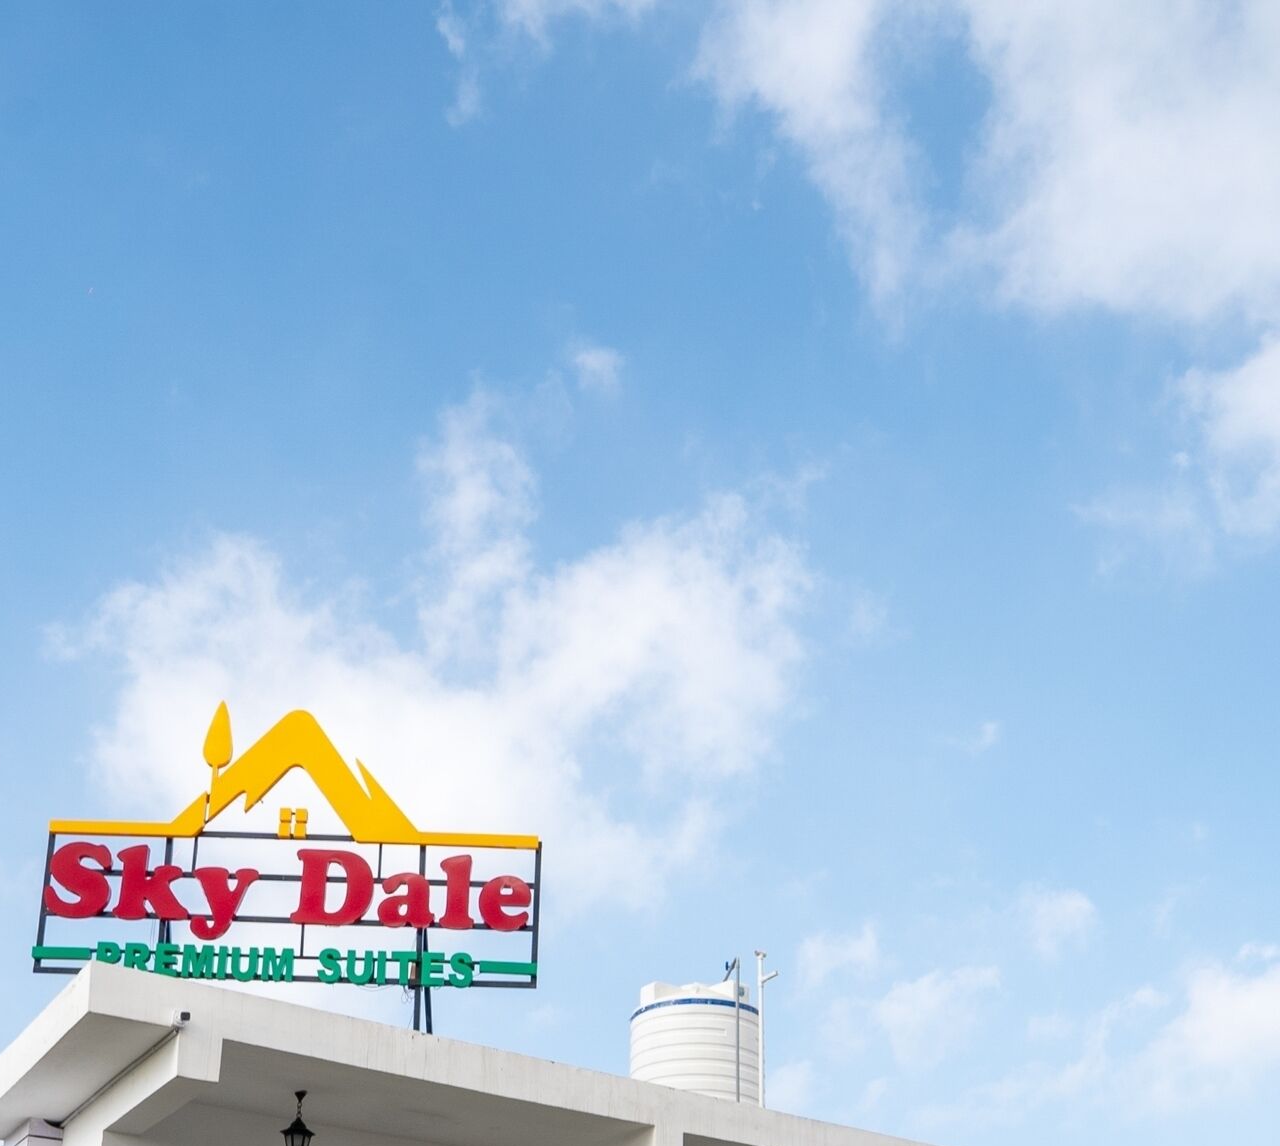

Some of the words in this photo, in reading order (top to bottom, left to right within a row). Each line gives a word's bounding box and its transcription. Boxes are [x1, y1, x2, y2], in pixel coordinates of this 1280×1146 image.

[44, 841, 259, 940] Sky
[289, 848, 531, 931] Dale
[96, 941, 295, 982] PREMIUM
[317, 947, 474, 988] SUITES
